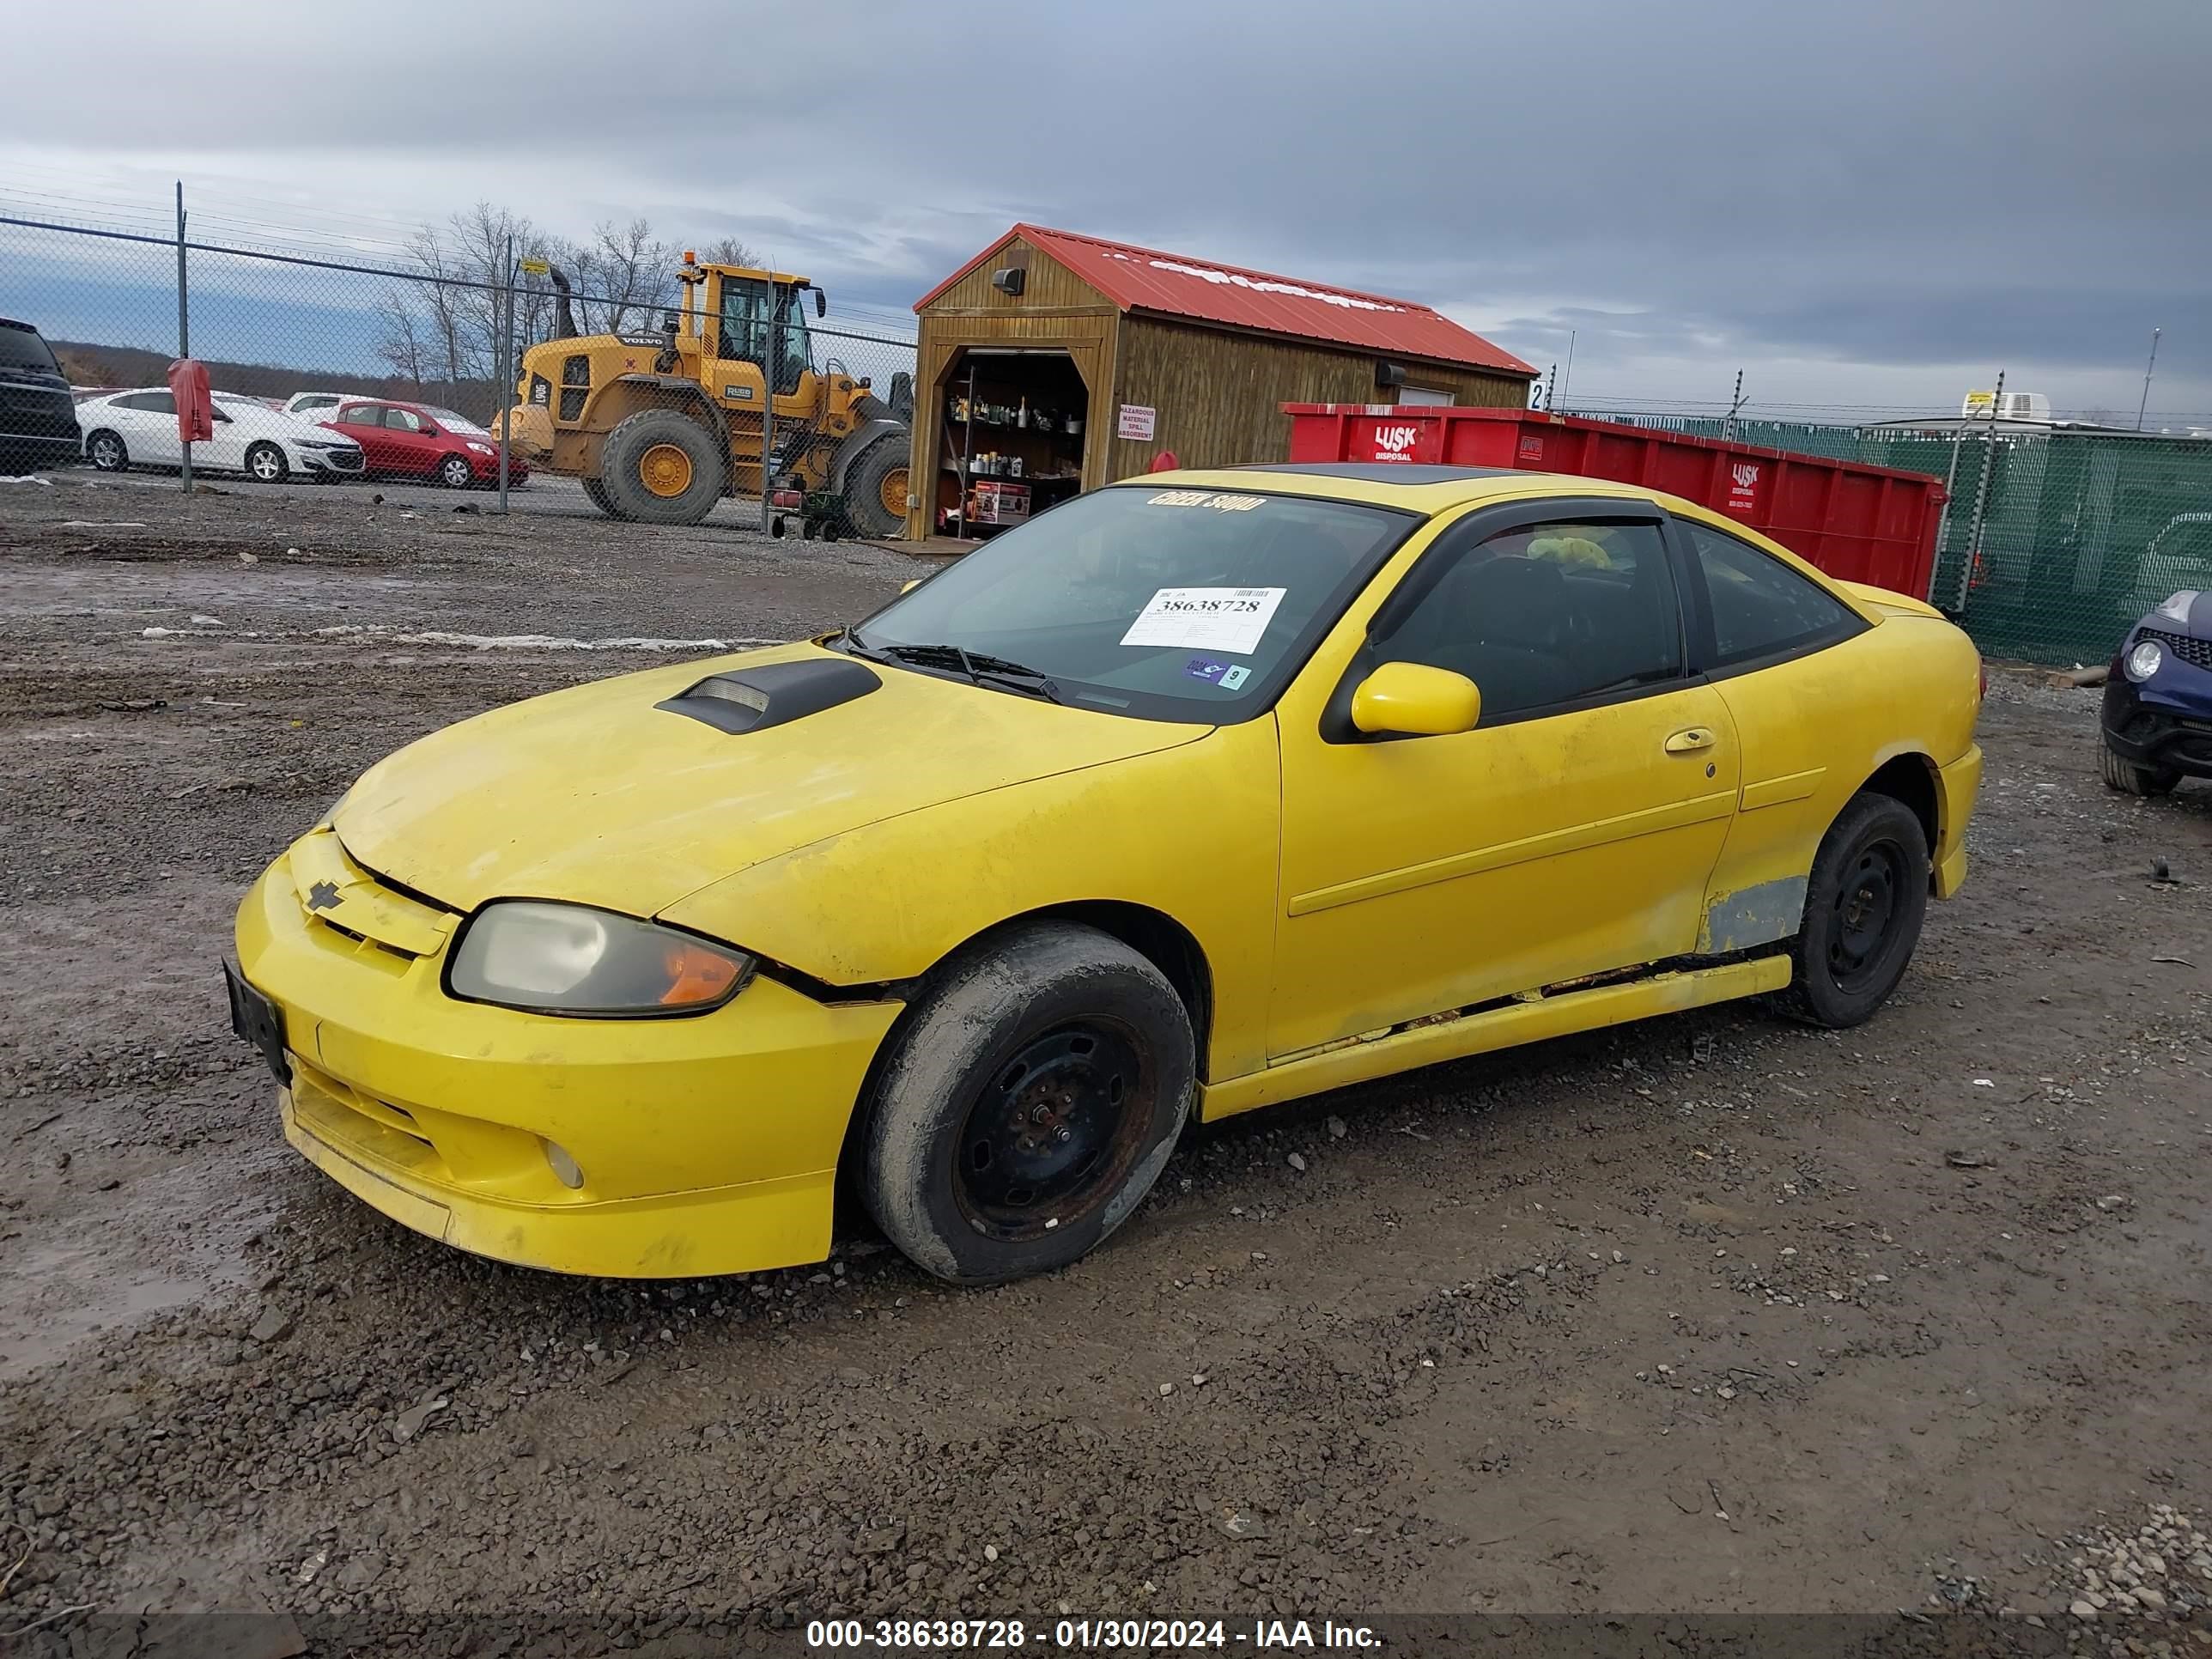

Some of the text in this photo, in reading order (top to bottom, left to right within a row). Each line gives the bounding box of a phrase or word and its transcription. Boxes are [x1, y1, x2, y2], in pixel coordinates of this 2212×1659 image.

[535, 384, 547, 403] L90G
[1531, 385, 1542, 409] 2
[1121, 407, 1154, 416] HAZARDOUS
[1122, 416, 1150, 424] MATERIAL
[1119, 430, 1152, 440] ABSORBENT
[1375, 426, 1417, 453] LUSK
[1375, 452, 1413, 462] DISPOSAL
[1732, 464, 1759, 488] LUSK
[1157, 600, 1261, 612] 38638728
[1229, 670, 1240, 680] 9
